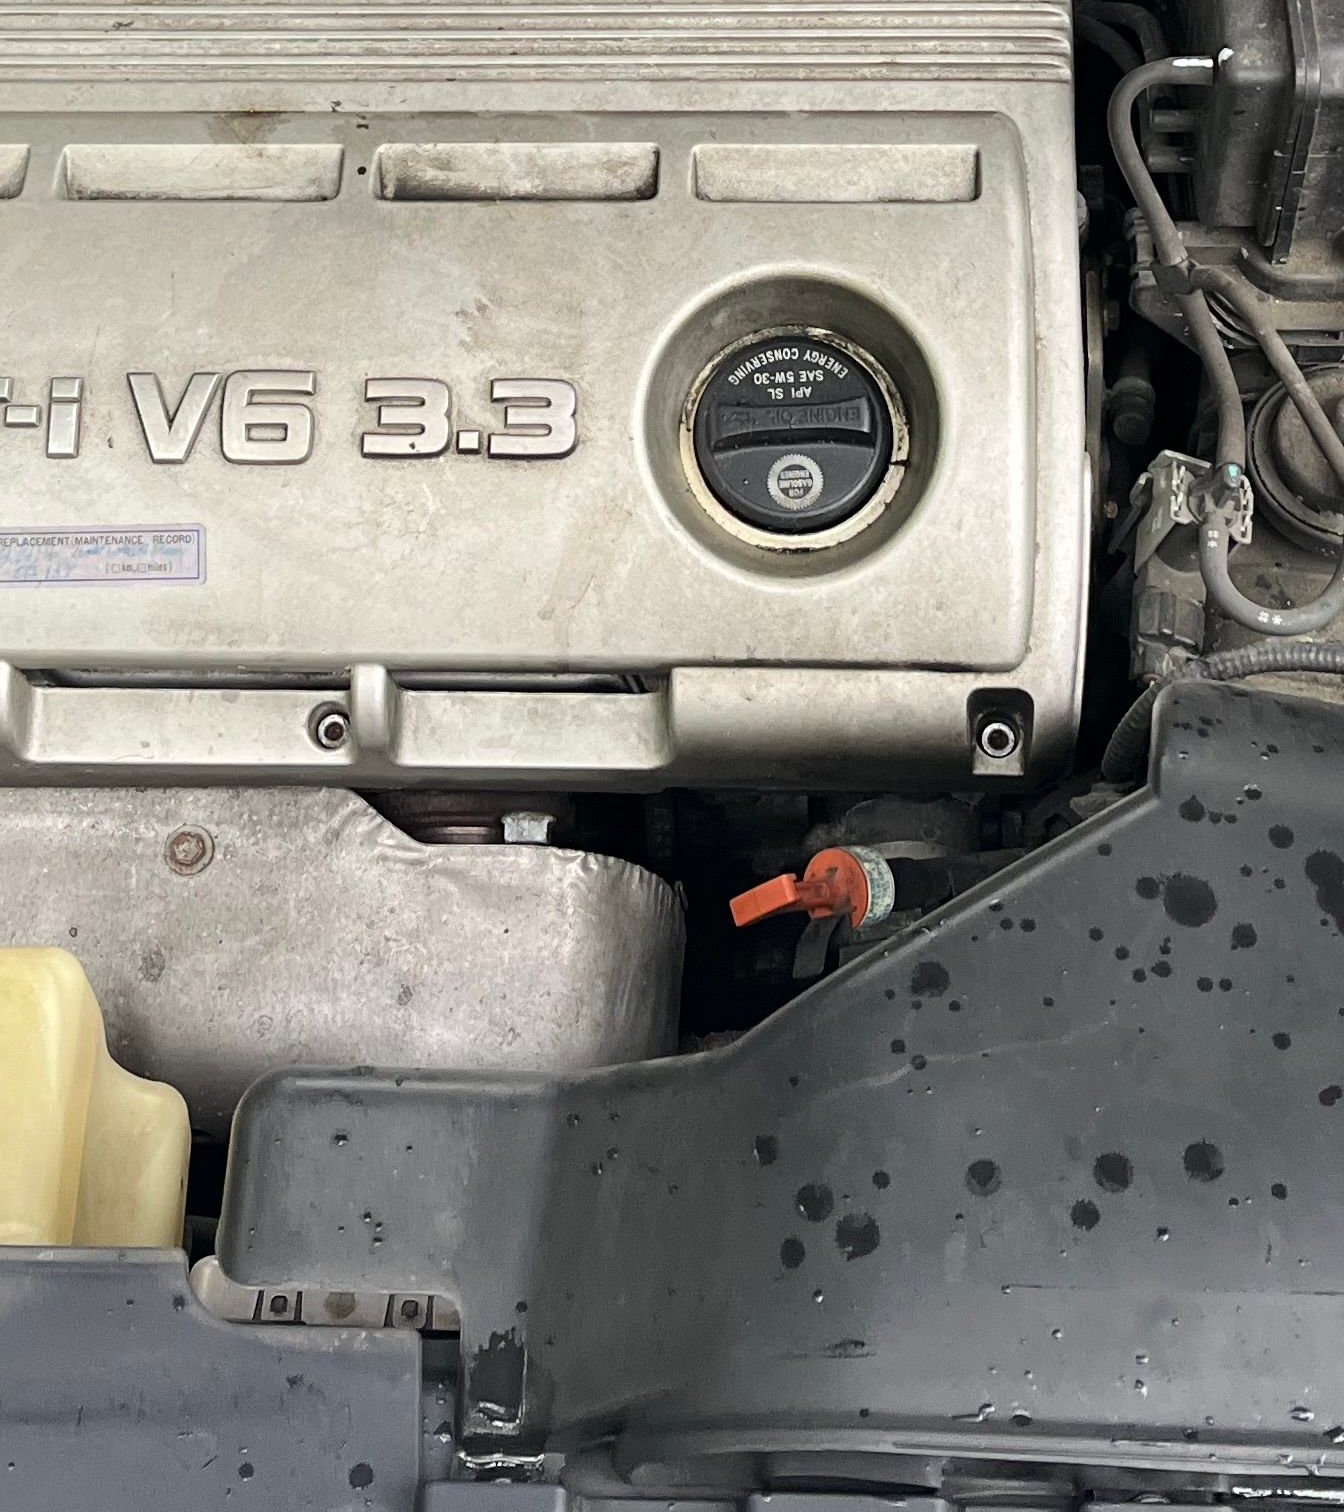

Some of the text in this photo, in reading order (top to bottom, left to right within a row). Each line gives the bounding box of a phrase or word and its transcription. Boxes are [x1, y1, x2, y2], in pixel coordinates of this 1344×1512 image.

[727, 348, 849, 385] ENERGY CONSERVING
[753, 369, 824, 385] SAE 5W-30
[766, 386, 812, 399] API SL
[129, 369, 314, 465] V6
[361, 376, 580, 460] 3.3
